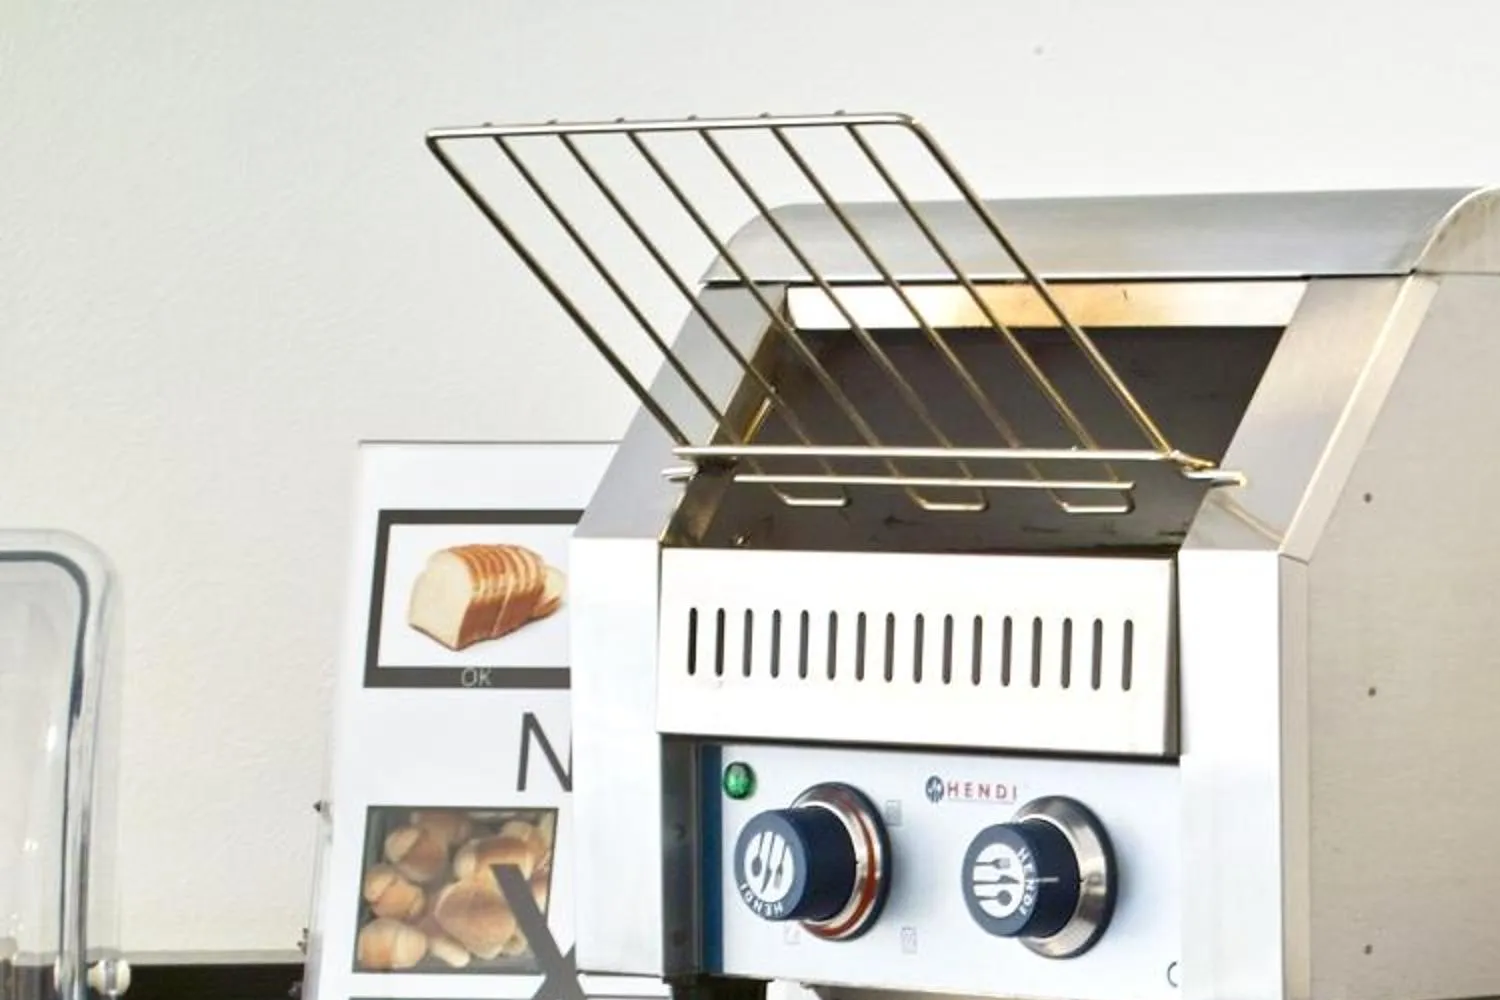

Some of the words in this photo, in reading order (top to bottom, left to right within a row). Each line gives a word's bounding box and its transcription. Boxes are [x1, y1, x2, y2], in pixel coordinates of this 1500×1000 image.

[461, 666, 492, 687] OK
[947, 782, 1017, 800] HENDI
[740, 882, 784, 917] HENDI
